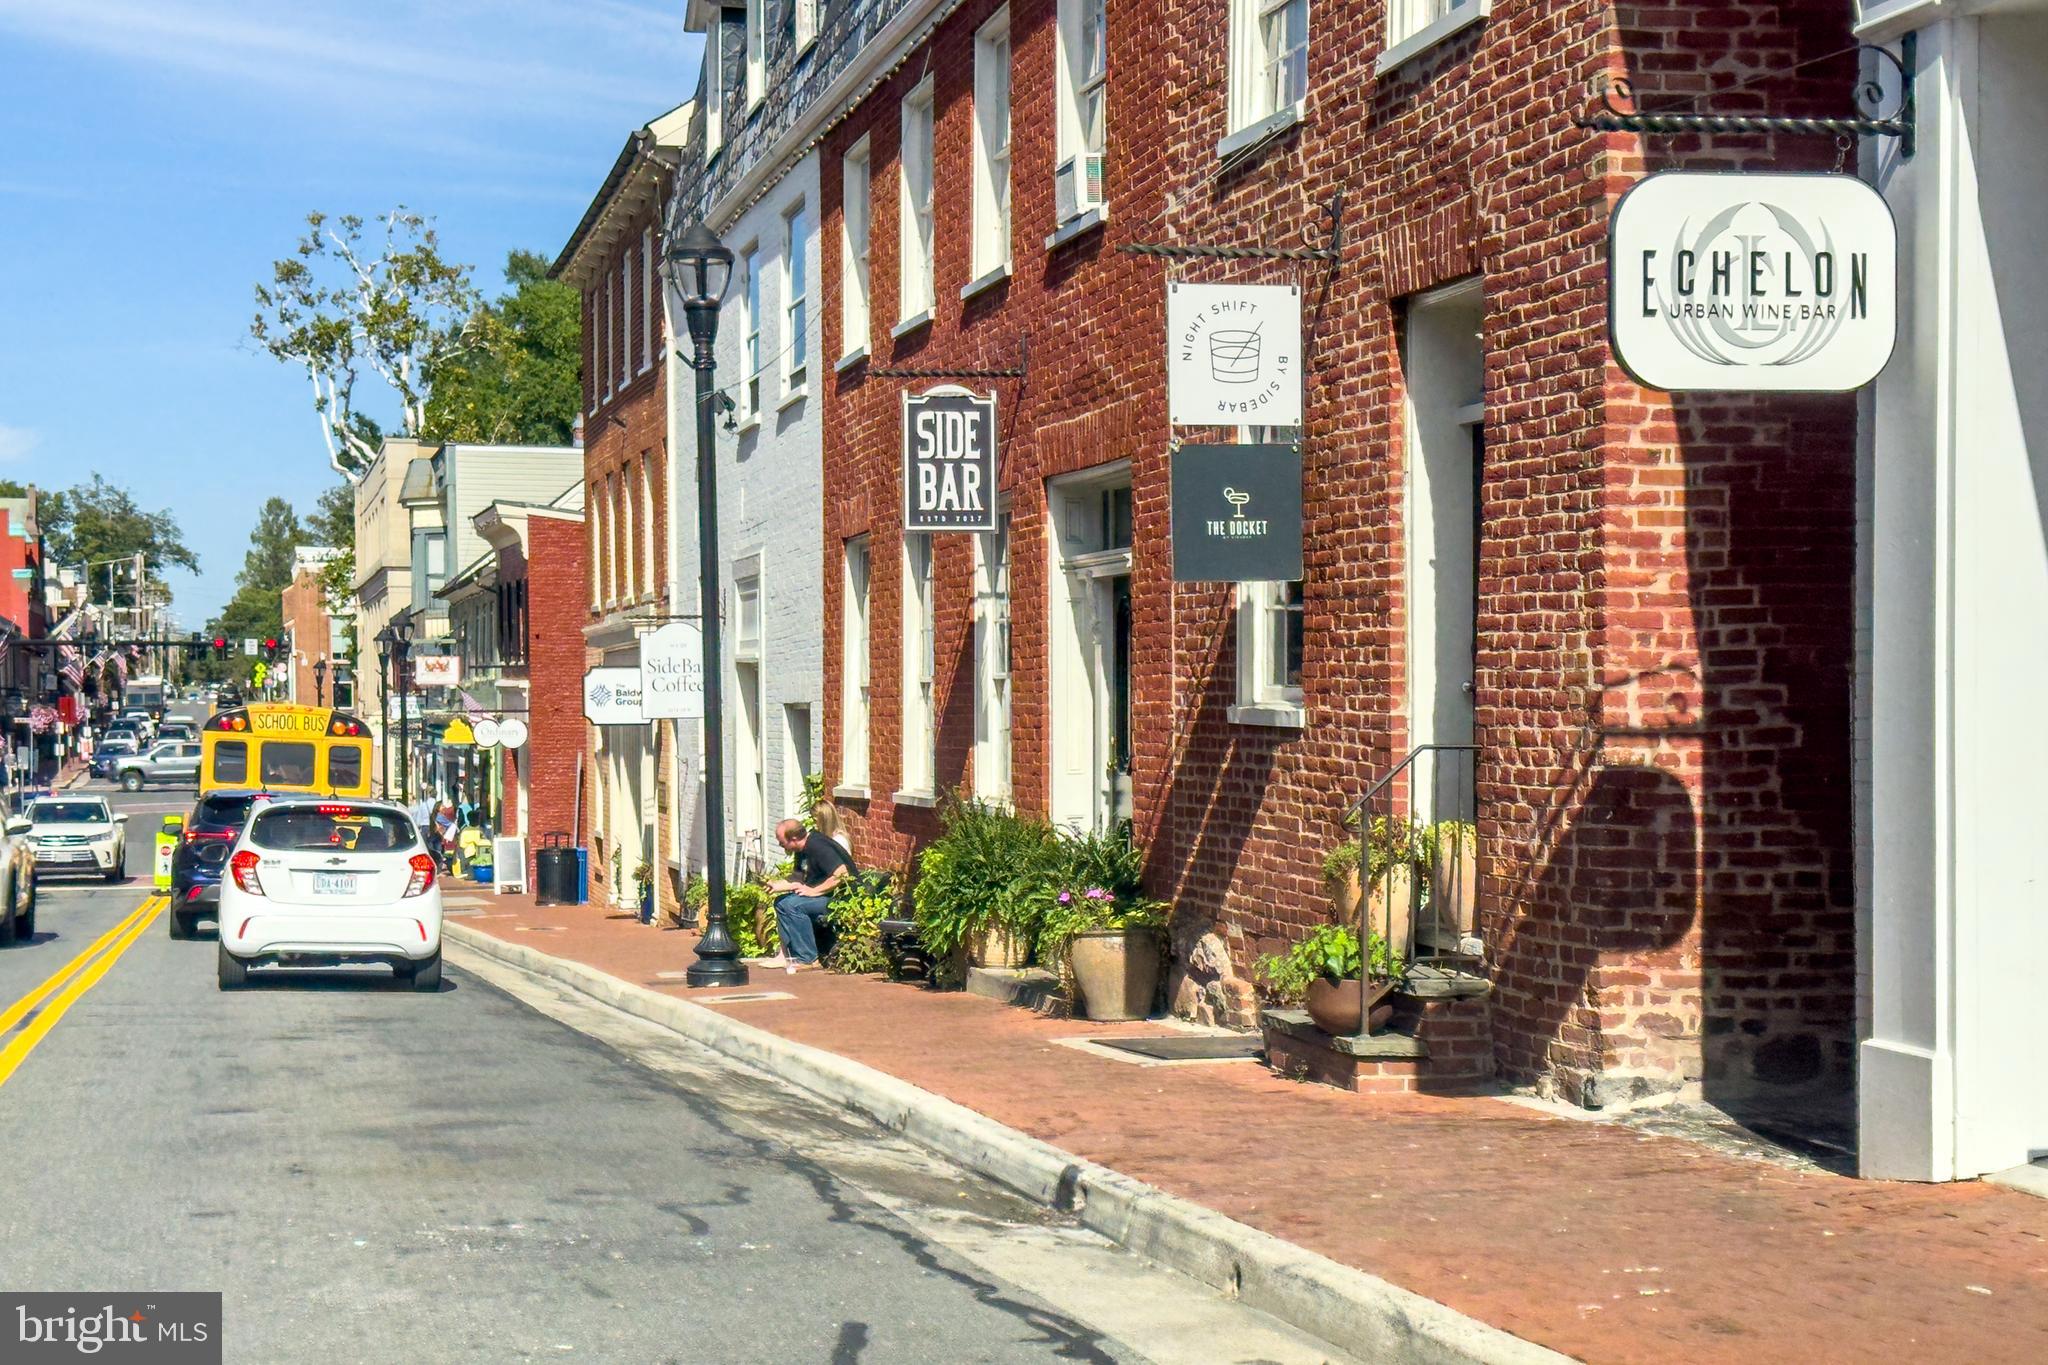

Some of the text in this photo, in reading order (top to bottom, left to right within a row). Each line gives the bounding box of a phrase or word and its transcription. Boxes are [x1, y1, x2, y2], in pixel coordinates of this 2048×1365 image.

[1642, 250, 1868, 320] ECHELON
[1182, 300, 1258, 361] NIGHT SHIFT
[1669, 303, 1837, 321] URBAN WINE BAR
[1217, 355, 1289, 413] BY SIDEBAR
[916, 410, 981, 460] SIDE
[917, 463, 984, 511] BAR
[955, 515, 982, 523] 2017
[1207, 520, 1268, 536] THE DOCKET
[258, 713, 326, 732] SCHOOL BUS
